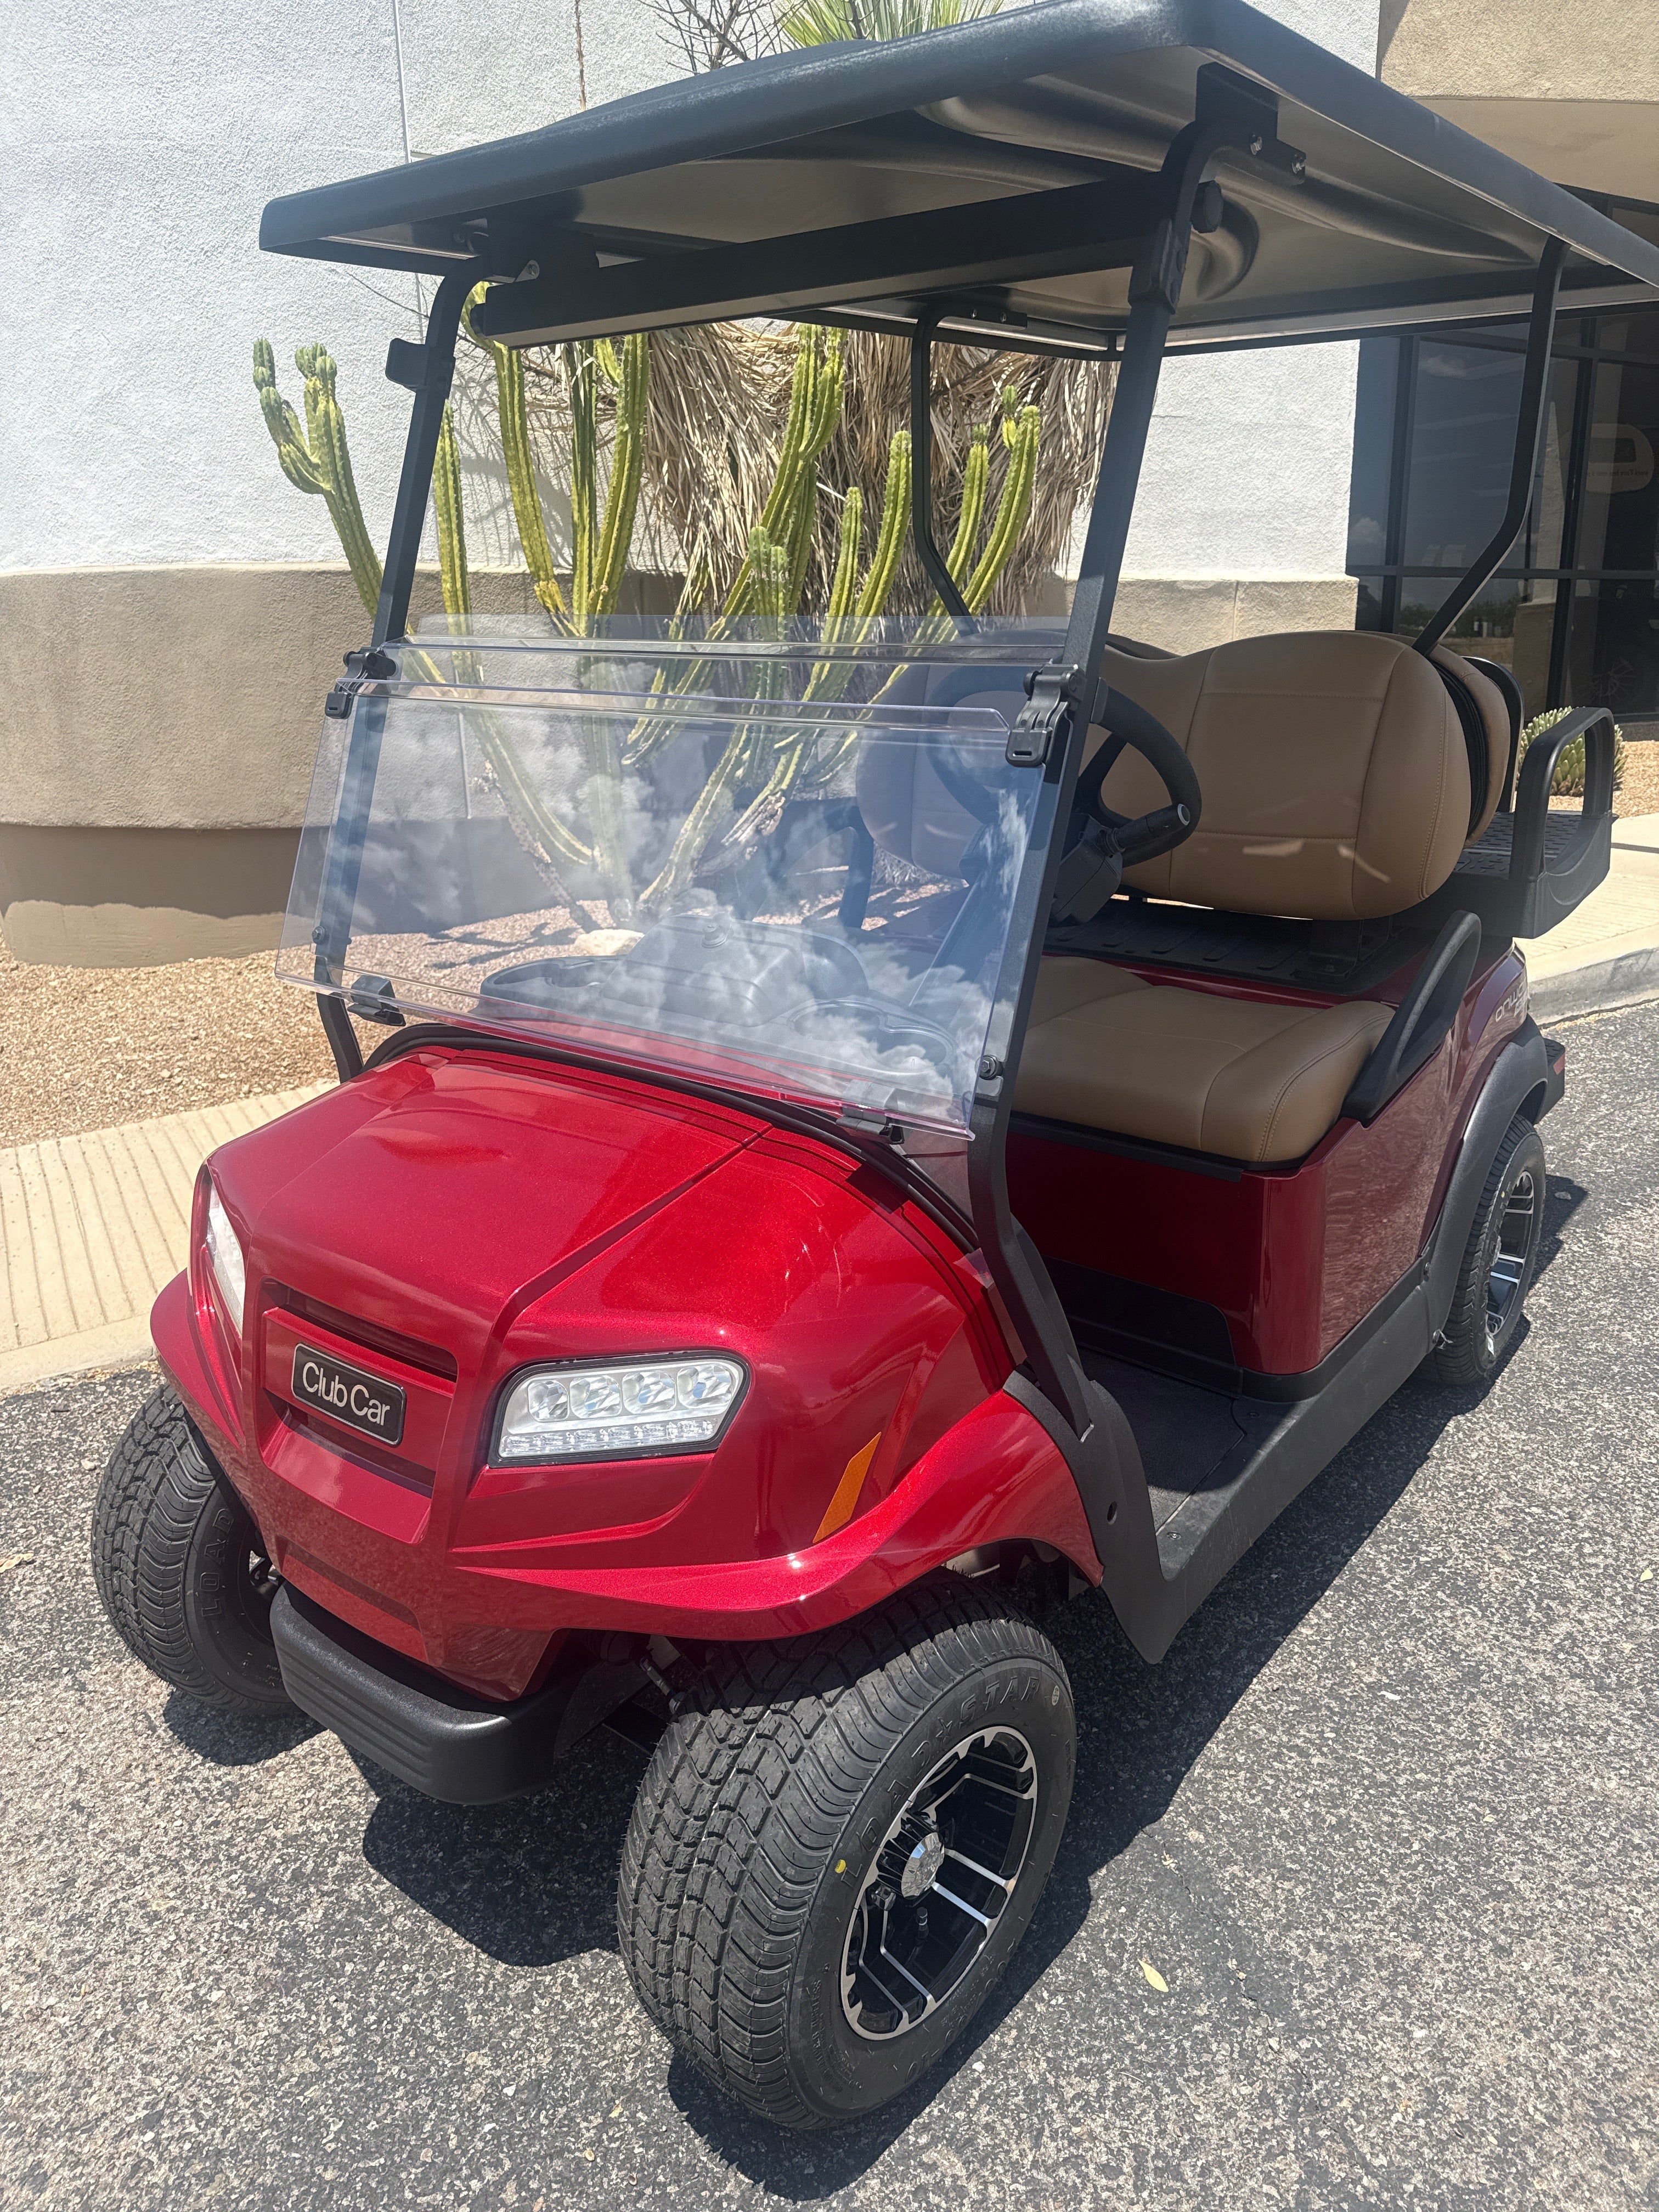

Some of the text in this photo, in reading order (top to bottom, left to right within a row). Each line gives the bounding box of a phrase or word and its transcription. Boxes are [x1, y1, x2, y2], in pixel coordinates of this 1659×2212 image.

[303, 1362, 390, 1426] Club Car
[200, 1508, 234, 1617] LOAD
